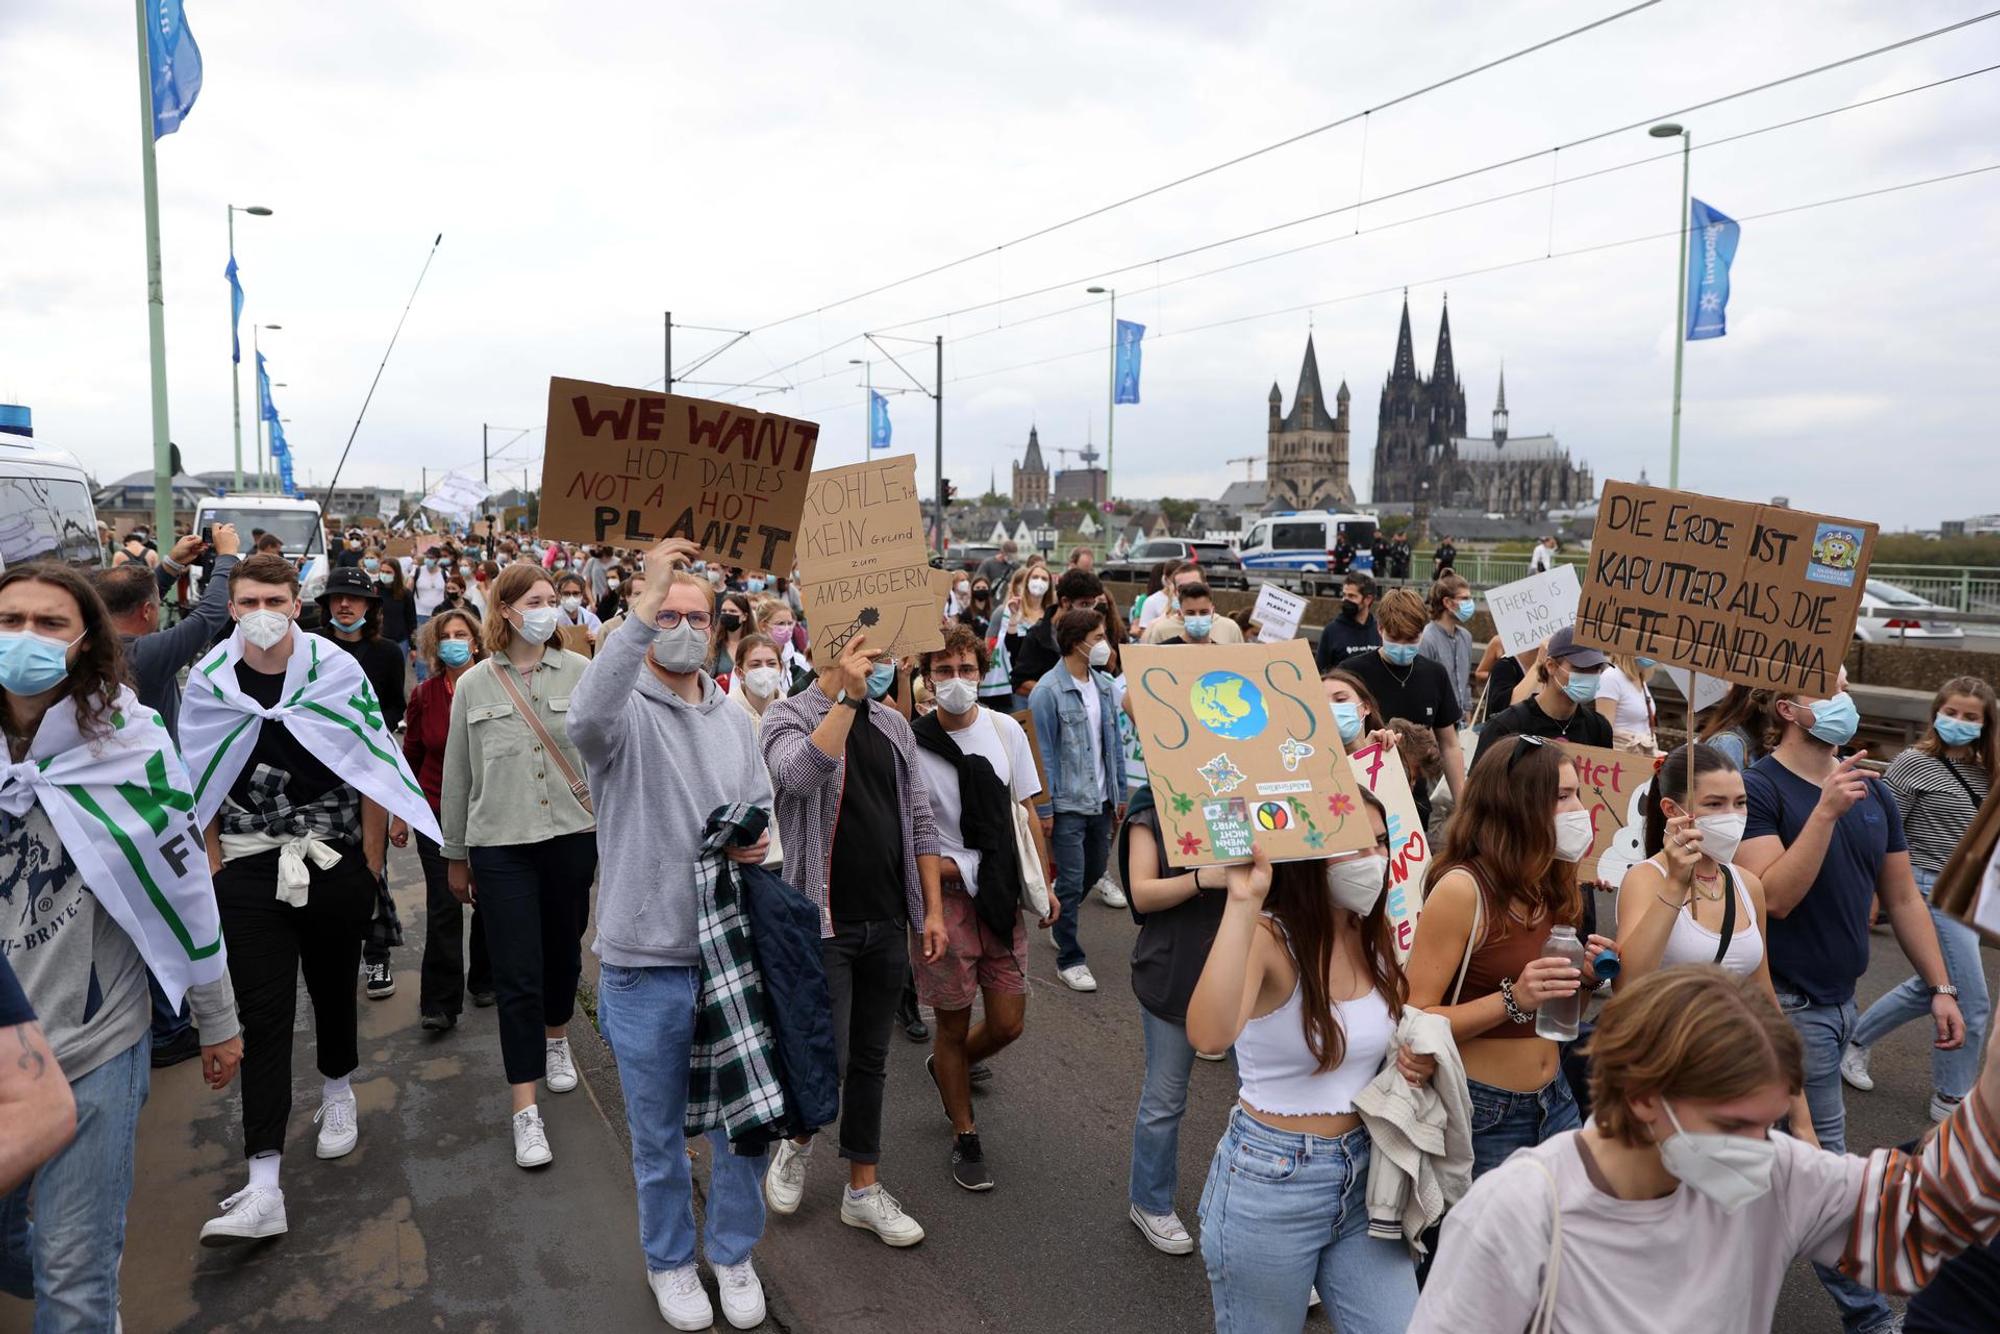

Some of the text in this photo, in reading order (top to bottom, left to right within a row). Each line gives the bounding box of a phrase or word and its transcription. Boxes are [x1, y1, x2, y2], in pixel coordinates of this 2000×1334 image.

[571, 395, 820, 472] WE WANT
[625, 447, 786, 493] HOT DATES
[566, 471, 769, 525] NOT A HOT
[802, 464, 917, 521] KOHLE ist
[594, 506, 792, 570] PLANET
[804, 517, 914, 559] KEIN Grund
[1607, 495, 1798, 565] DIE ERDE IST
[851, 557, 878, 568] zum
[814, 566, 931, 607] ANBAGGERN
[1493, 581, 1561, 615] THERE IS
[1595, 549, 1836, 635] KAPUTTER ALS DIE
[1512, 618, 1564, 647] PLANET
[1526, 604, 1549, 625] NO
[1581, 596, 1826, 693] HÜFTE DEINER OMA
[1212, 821, 1239, 831] WIR?
[1215, 839, 1247, 848] WENN
[1220, 829, 1248, 838] NICHT
